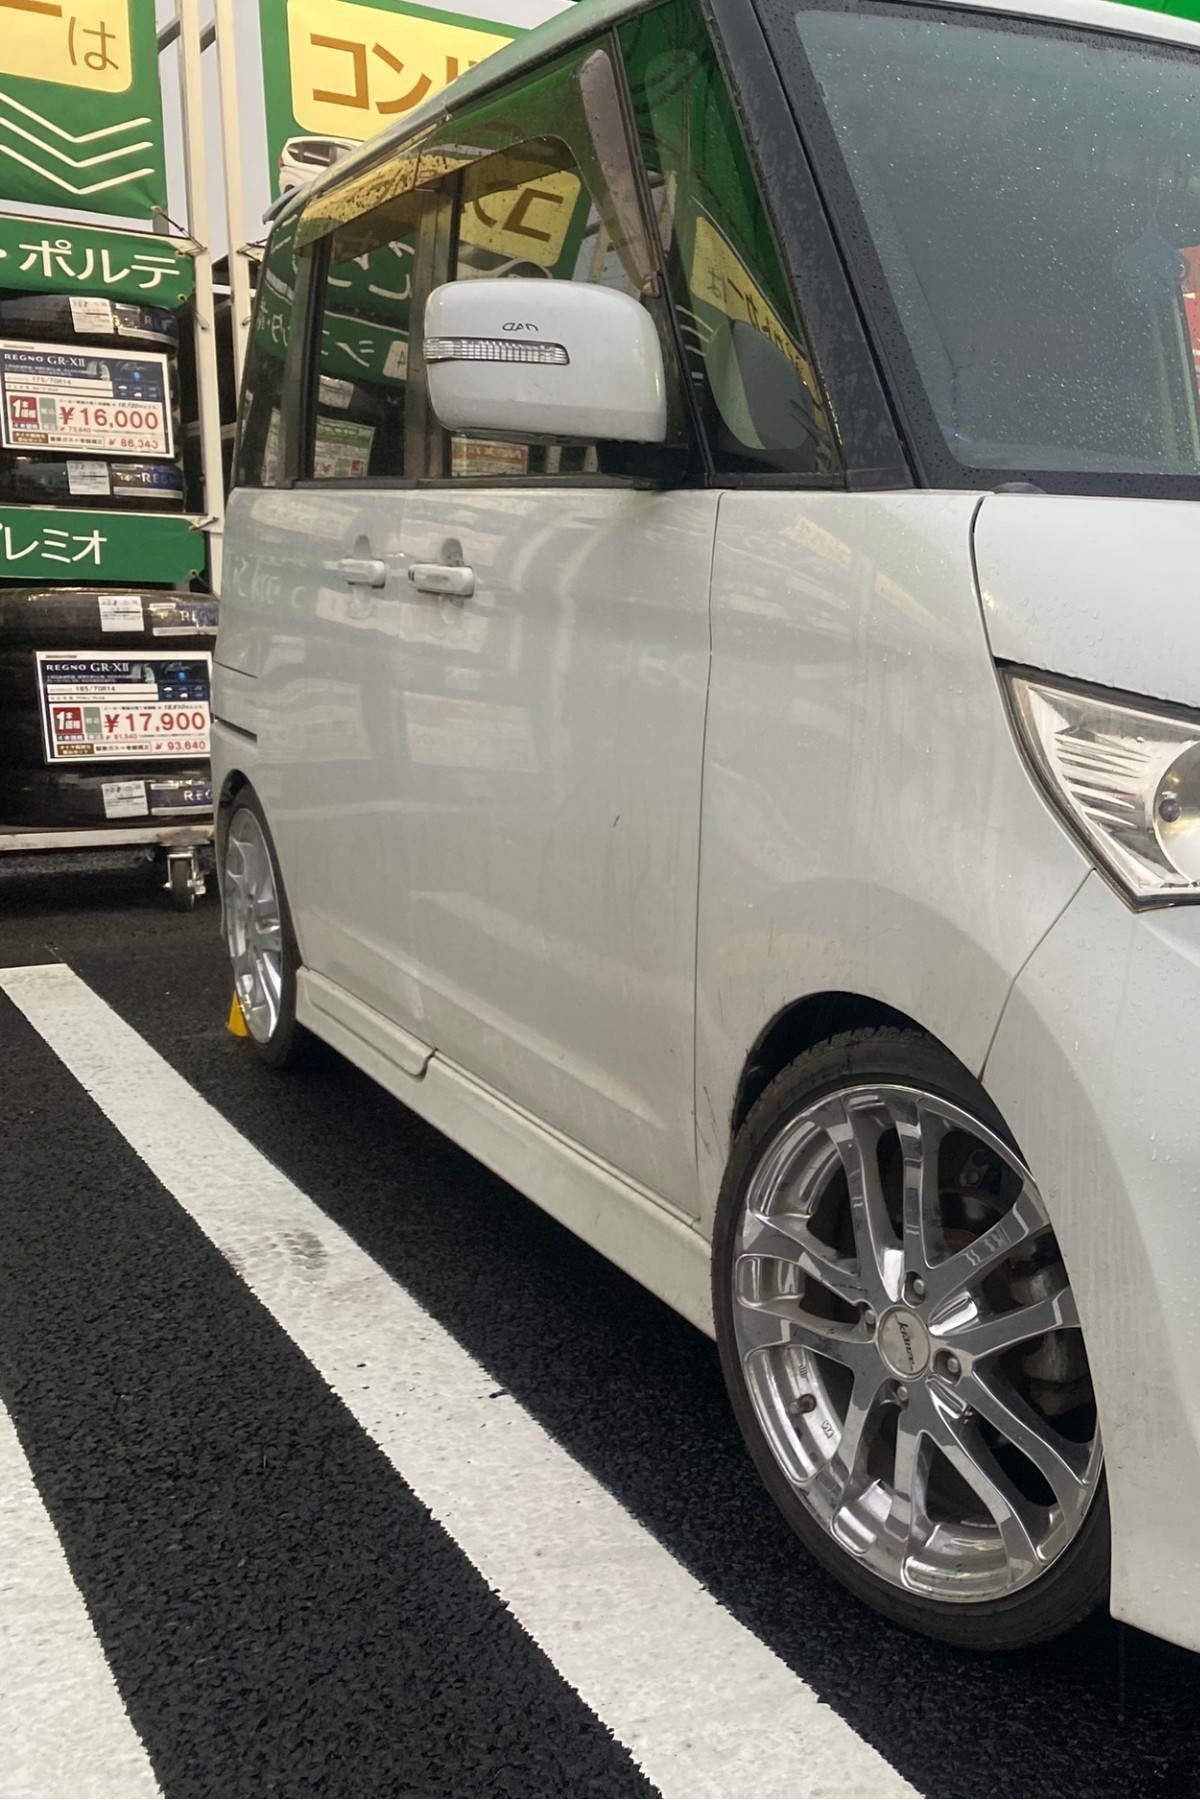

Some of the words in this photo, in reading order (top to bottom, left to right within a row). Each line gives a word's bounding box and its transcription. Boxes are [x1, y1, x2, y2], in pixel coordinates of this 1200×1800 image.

[310, 33, 476, 114] コン
[4, 353, 43, 362] REGNO
[0, 522, 107, 564] レミオ
[104, 711, 206, 733] ¥17,900
